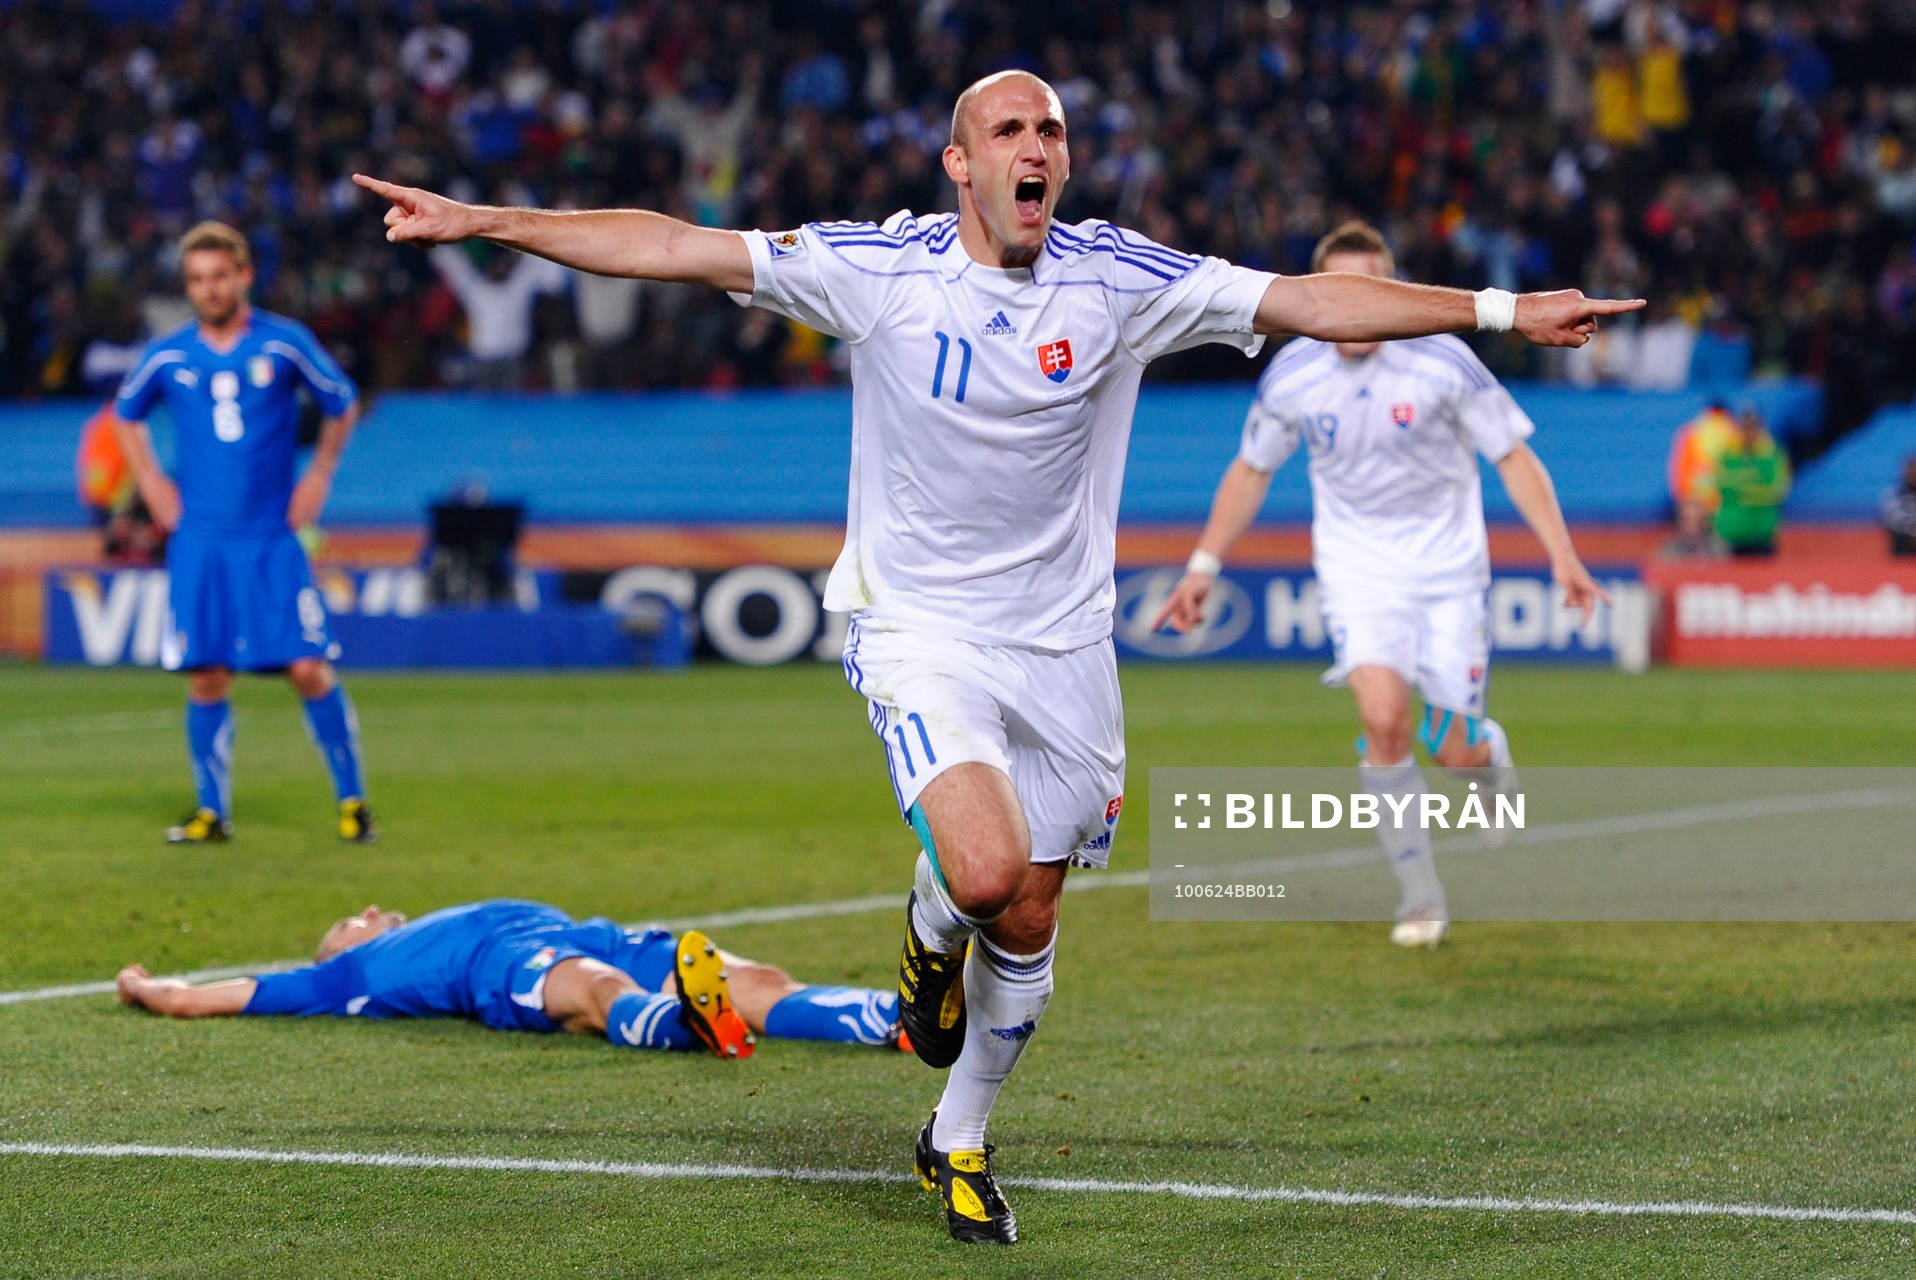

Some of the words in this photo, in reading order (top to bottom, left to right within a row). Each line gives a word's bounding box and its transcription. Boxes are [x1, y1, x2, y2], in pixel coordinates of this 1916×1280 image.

[981, 326, 1017, 336] adidas
[931, 331, 972, 403] 11
[893, 712, 937, 778] 11
